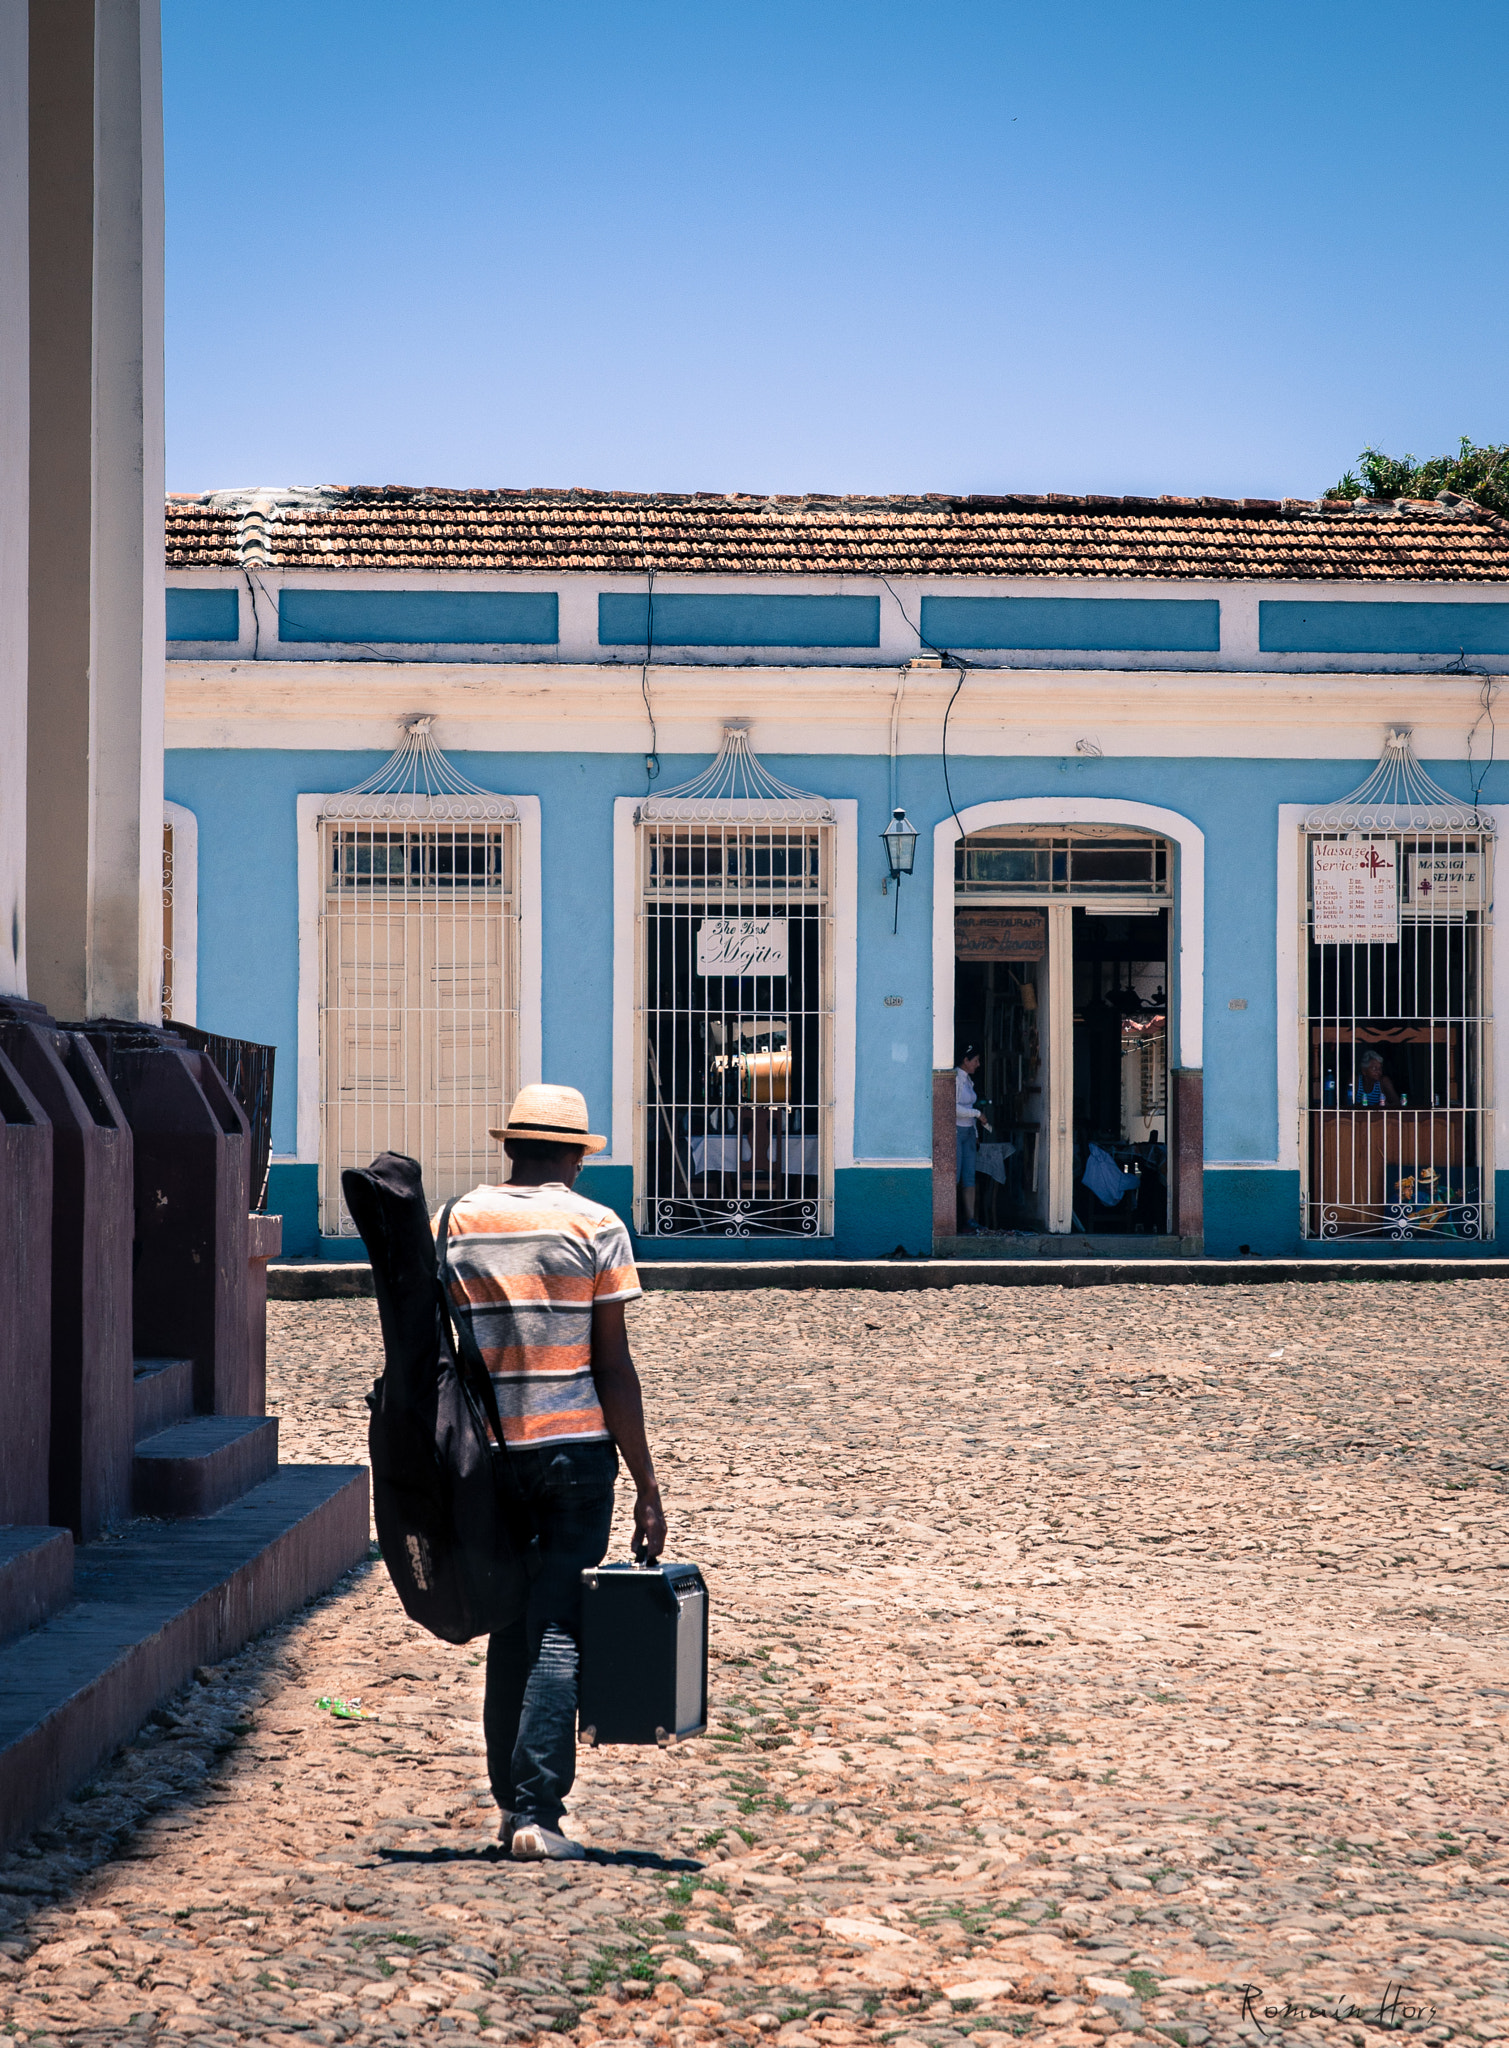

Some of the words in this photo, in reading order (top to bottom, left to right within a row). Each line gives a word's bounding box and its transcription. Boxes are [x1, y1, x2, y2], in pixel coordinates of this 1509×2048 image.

[712, 920, 736, 934] The
[740, 920, 770, 934] Best
[700, 934, 784, 974] Mojito
